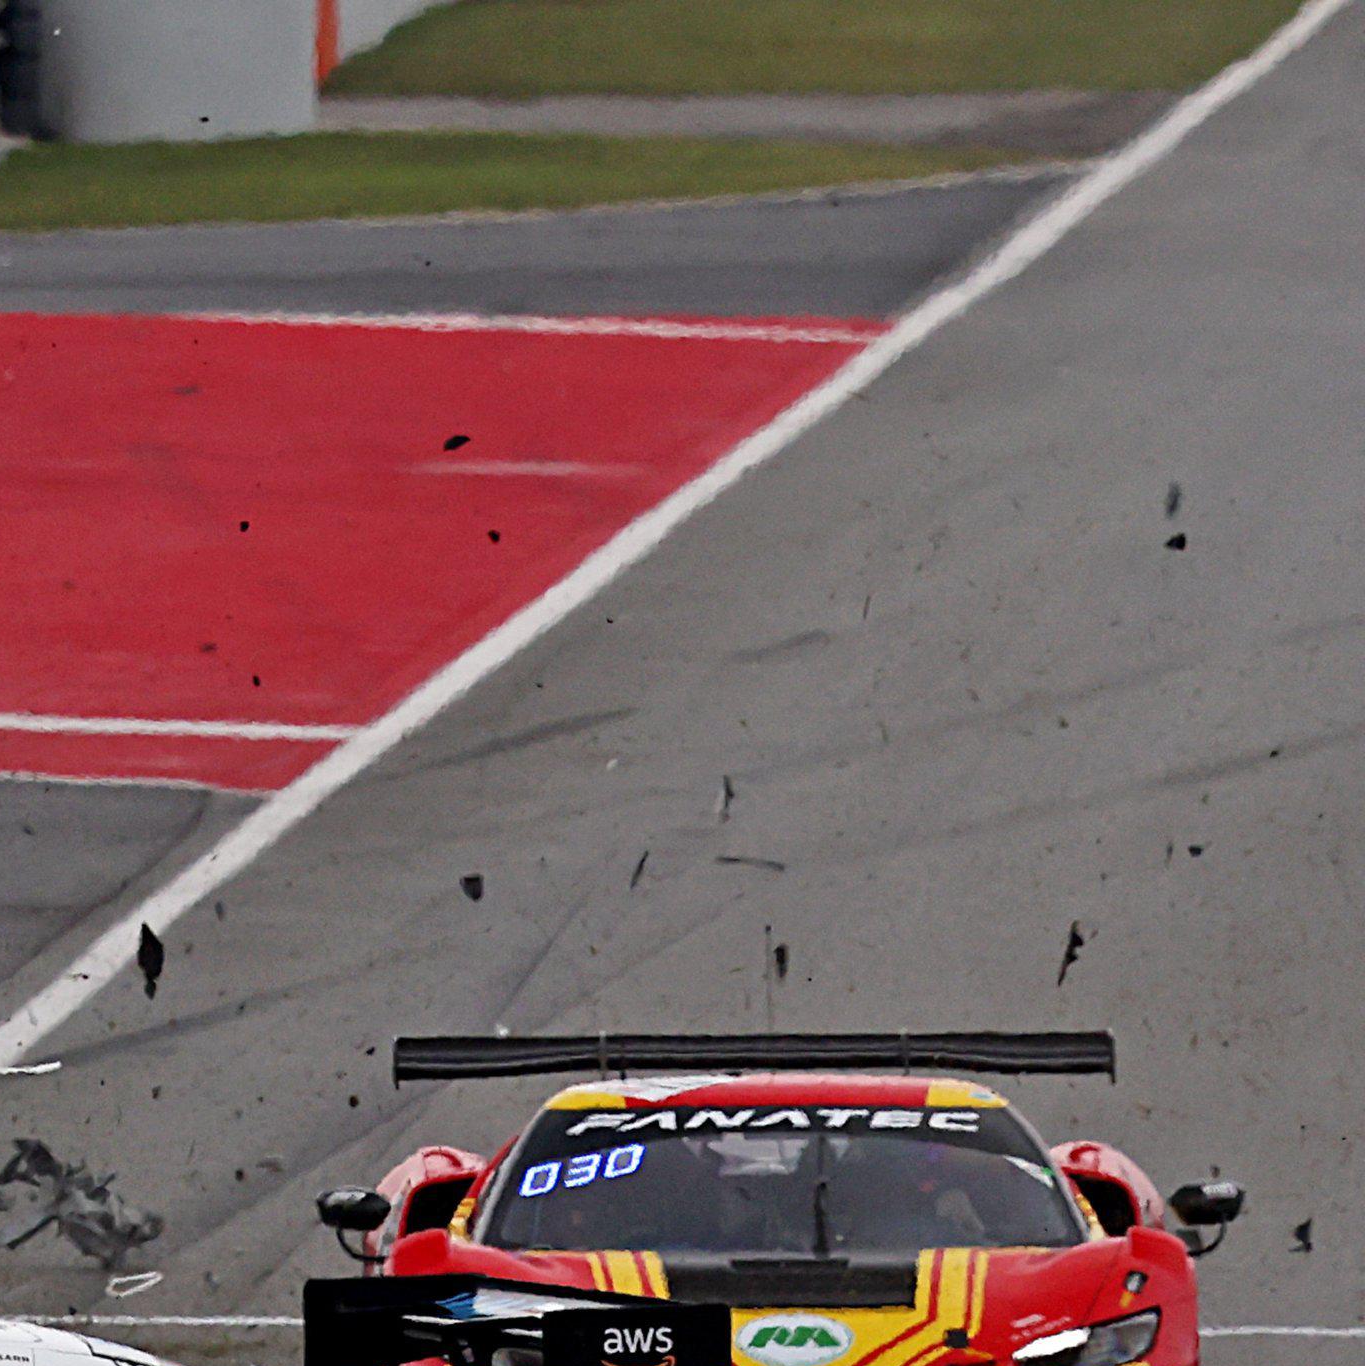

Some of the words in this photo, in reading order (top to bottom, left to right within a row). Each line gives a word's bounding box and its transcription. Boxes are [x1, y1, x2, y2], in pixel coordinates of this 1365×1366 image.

[568, 1108, 980, 1136] FANATEC
[519, 1143, 646, 1198] 030
[603, 1325, 673, 1354] aws
